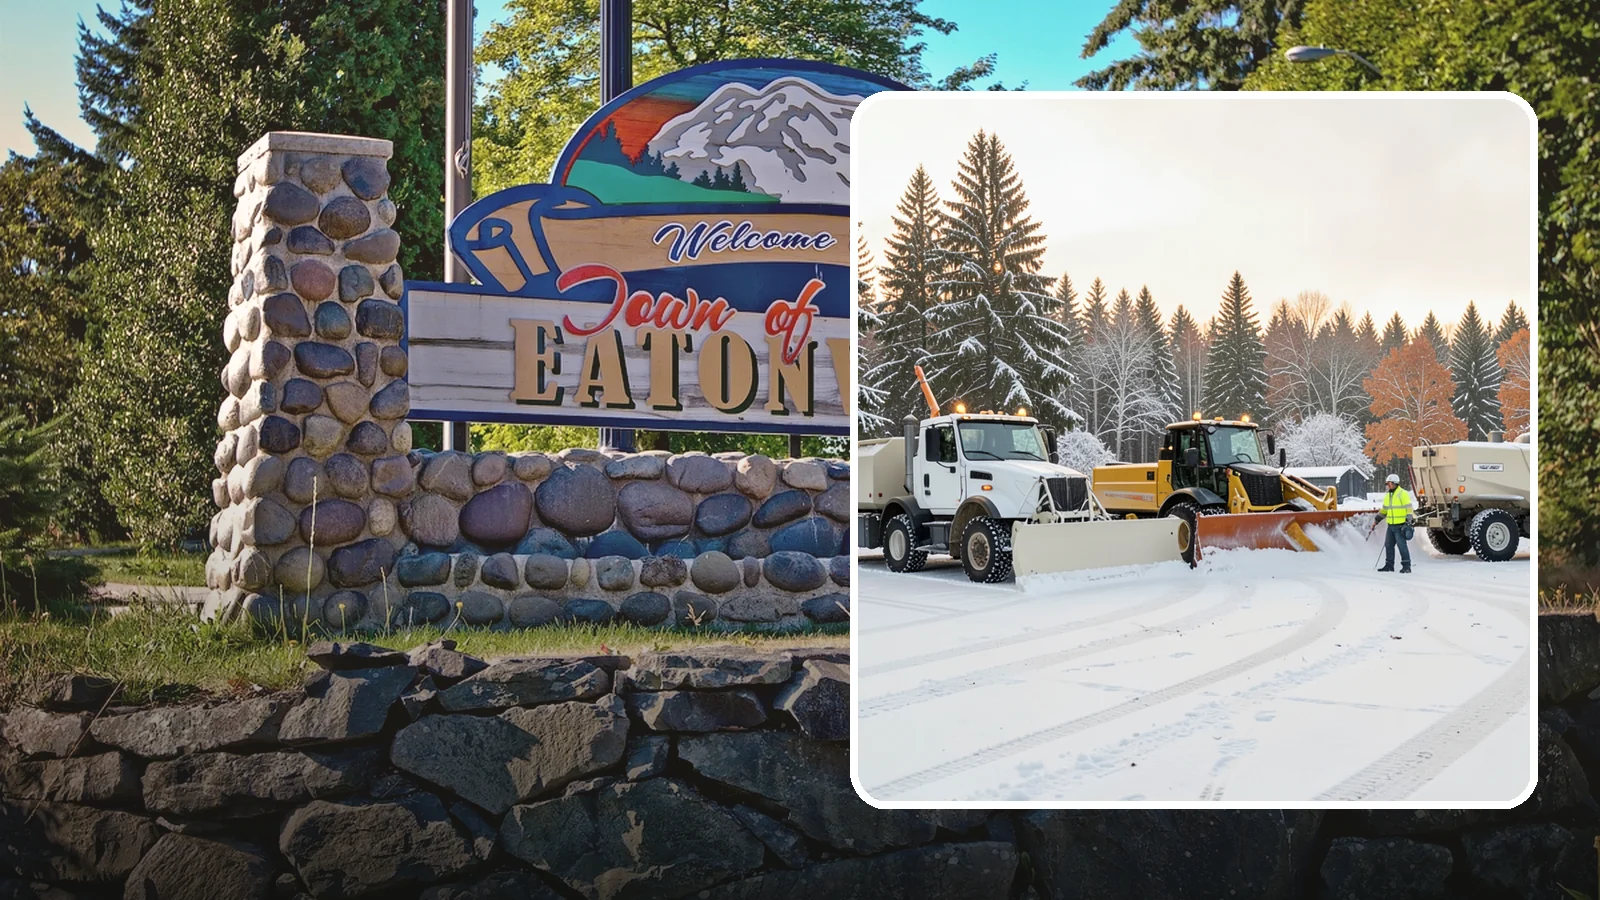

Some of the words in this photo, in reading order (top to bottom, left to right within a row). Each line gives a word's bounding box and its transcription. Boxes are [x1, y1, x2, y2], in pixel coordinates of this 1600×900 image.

[653, 220, 838, 263] Welcome
[557, 263, 737, 336] Town
[764, 278, 826, 365] of
